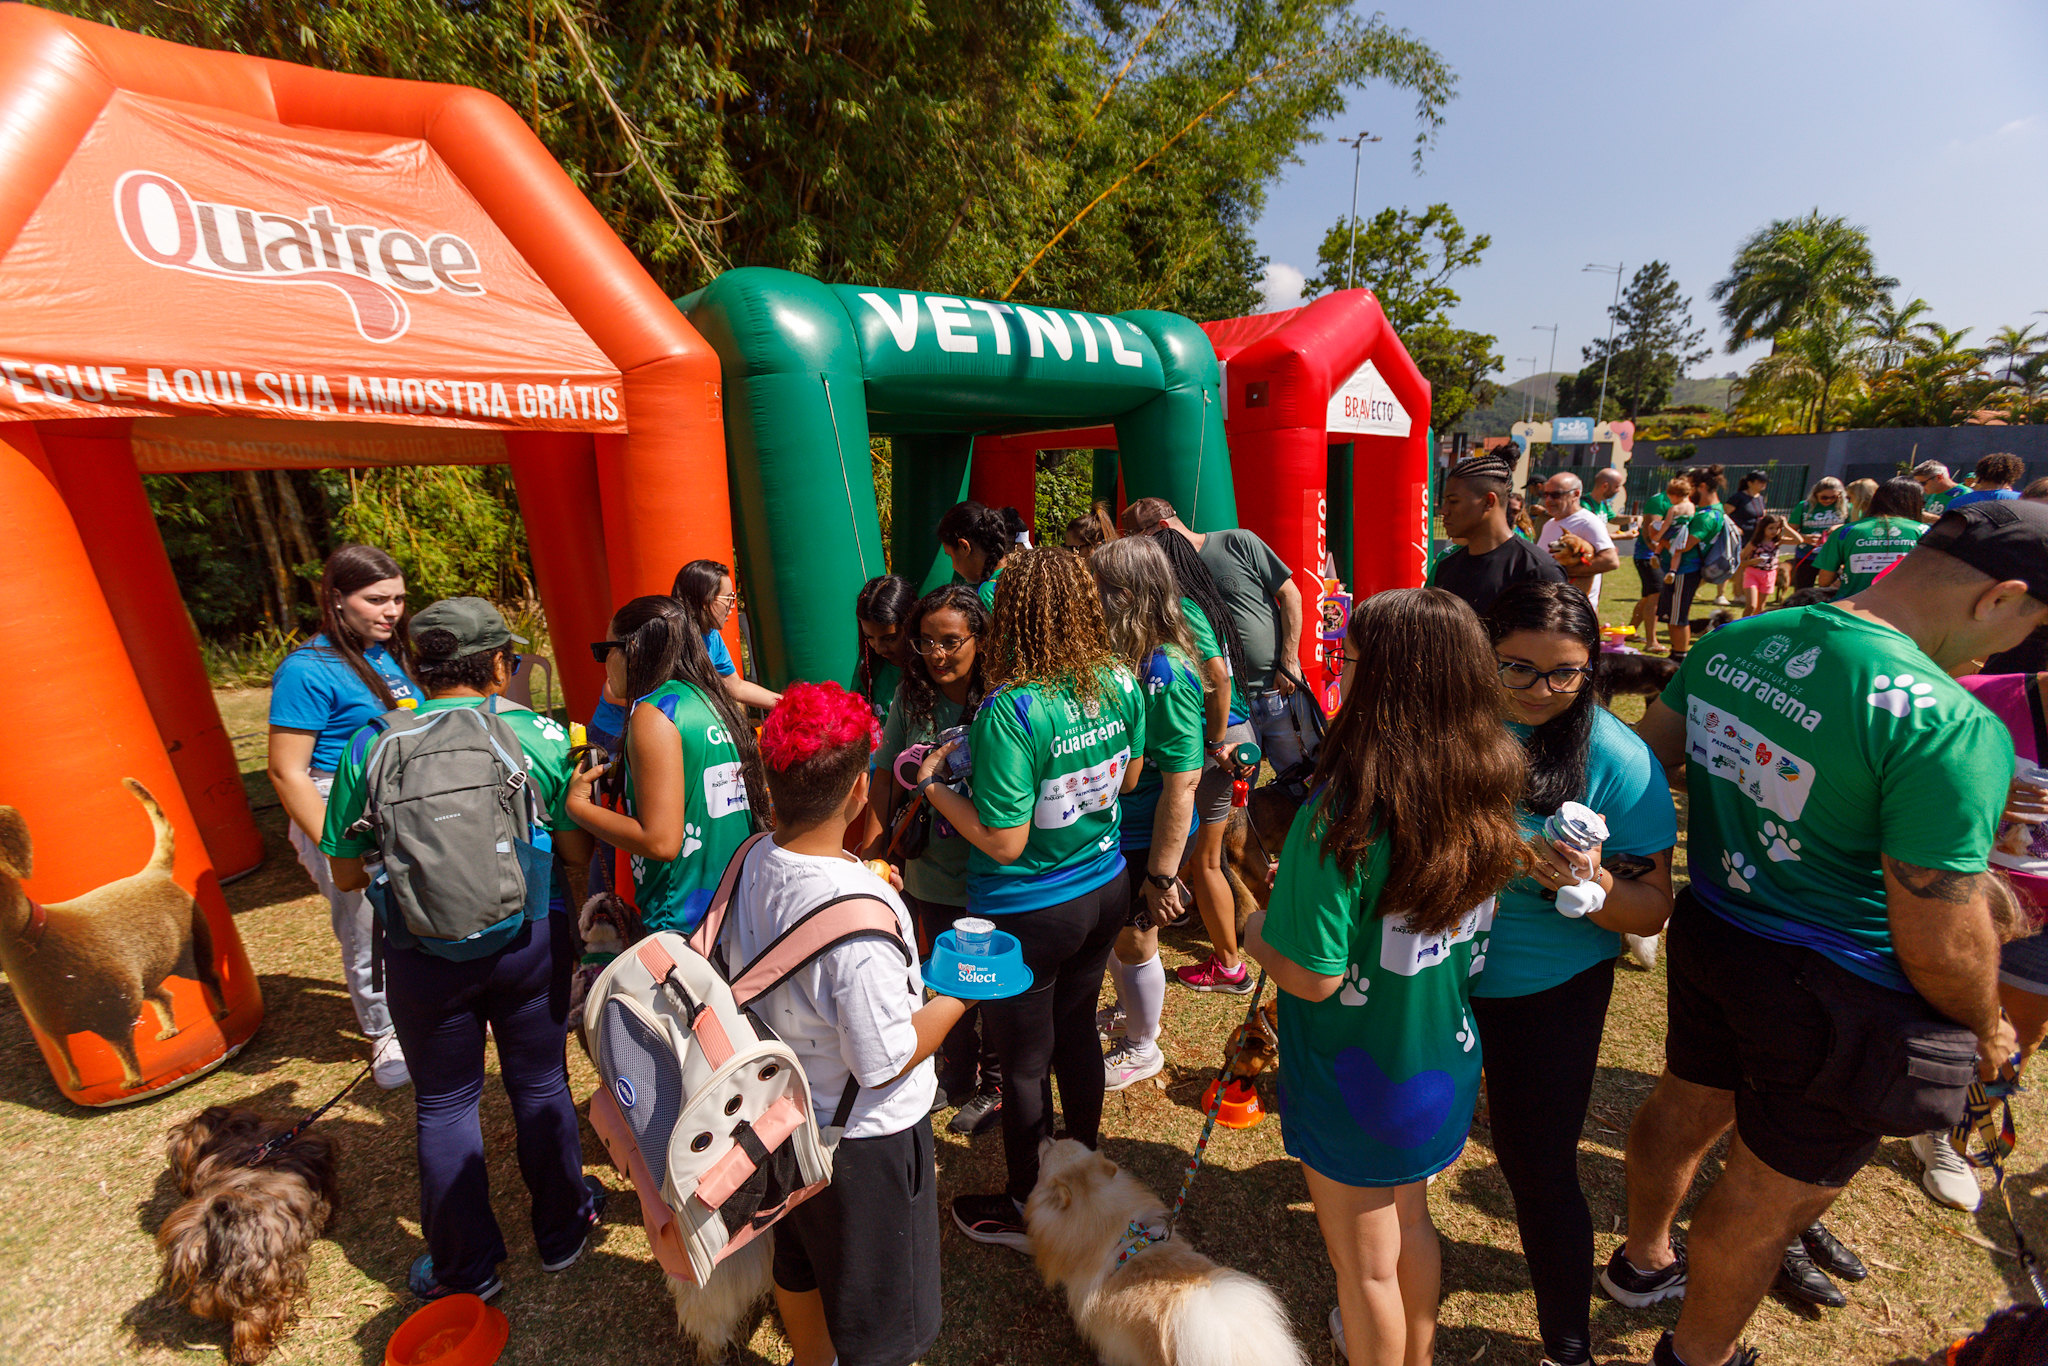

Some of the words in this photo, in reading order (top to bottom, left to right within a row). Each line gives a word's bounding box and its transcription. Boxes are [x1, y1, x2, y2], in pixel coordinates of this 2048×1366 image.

[115, 170, 486, 343] Quatree
[0, 360, 136, 404] EGUE
[147, 368, 249, 405] AQUI
[255, 372, 338, 414] SUA
[348, 375, 513, 419] AMOSTRA
[516, 379, 620, 421] GRÁTIS
[1345, 388, 1394, 425] BRAVECTO
[1705, 653, 1823, 733] Guararema
[1734, 656, 1788, 688] PREFEITURA
[1790, 684, 1804, 695] DE
[958, 970, 997, 983] Select
